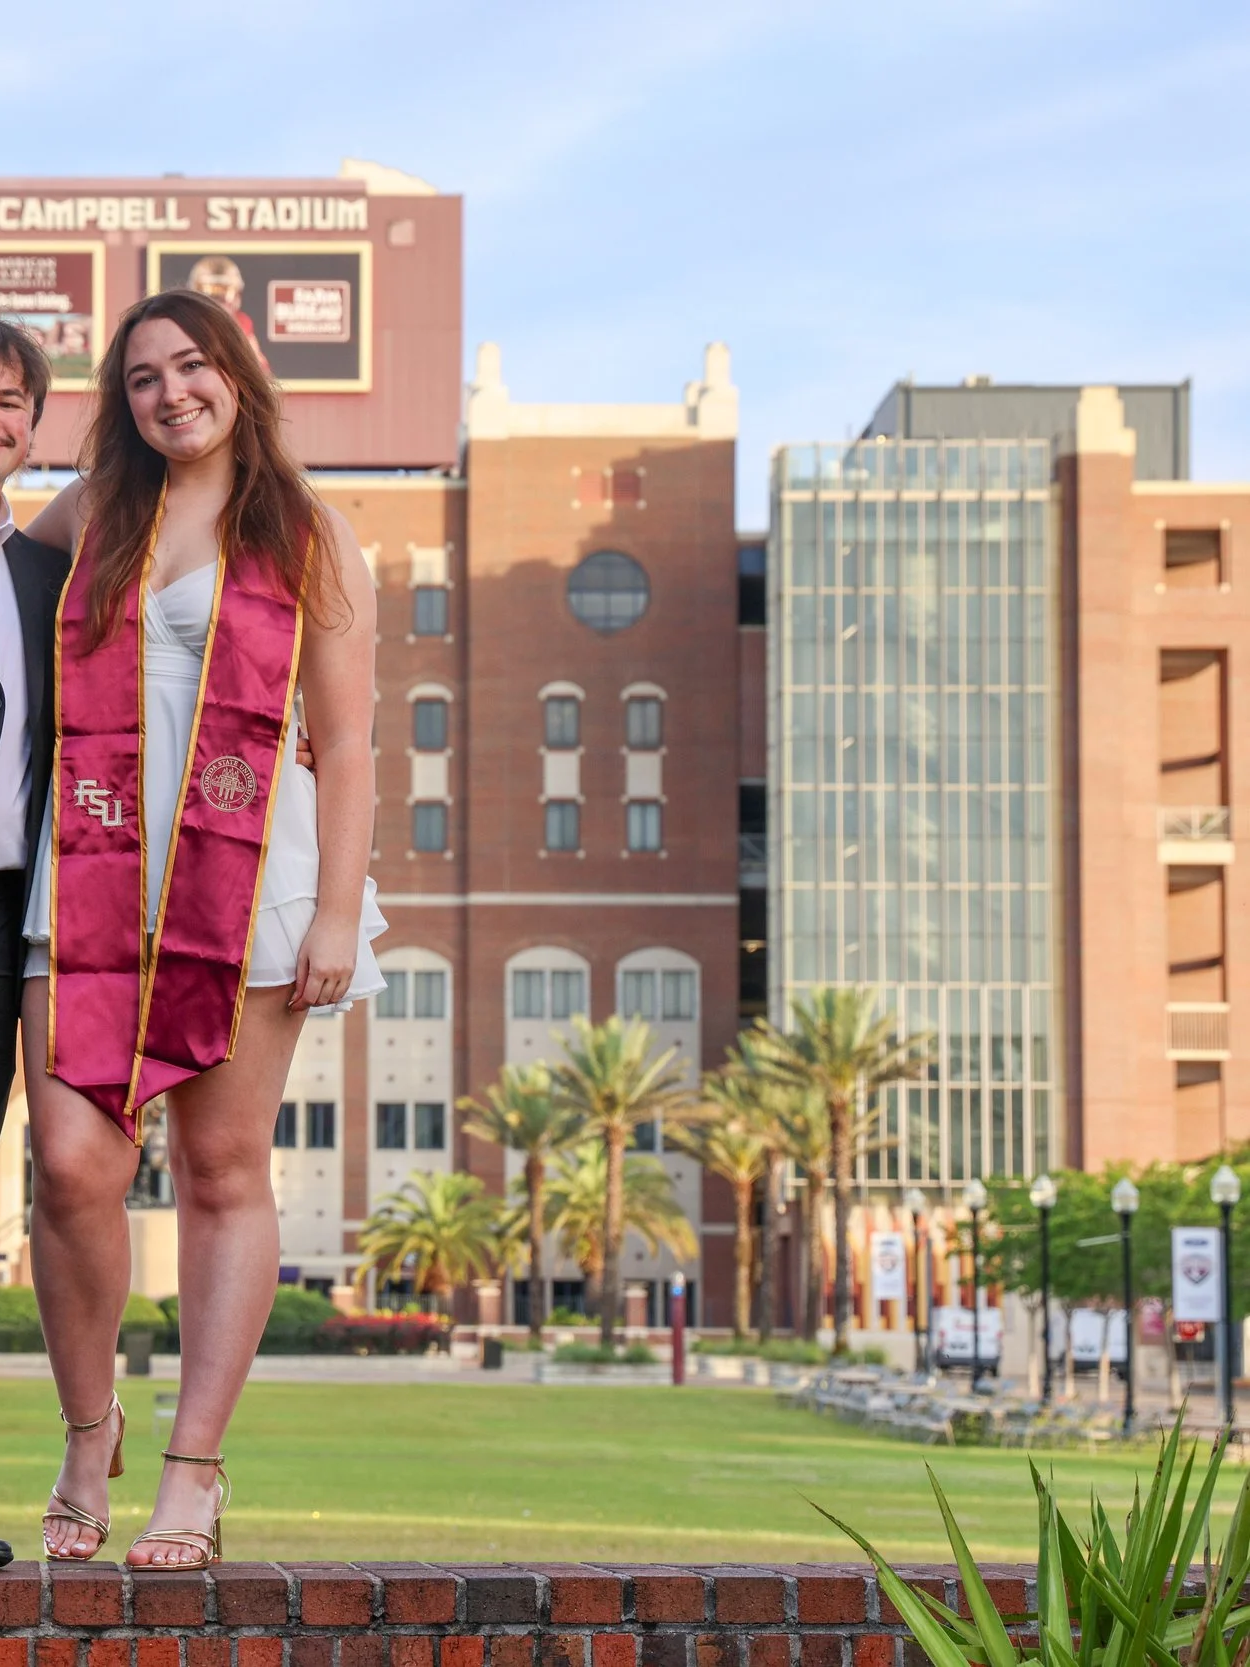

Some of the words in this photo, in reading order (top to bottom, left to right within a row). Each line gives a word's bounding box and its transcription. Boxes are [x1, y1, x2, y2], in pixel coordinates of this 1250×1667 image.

[206, 196, 369, 231] STADIUM
[72, 779, 124, 827] FSU
[203, 764, 218, 794] FLORIDA
[217, 759, 239, 767] STATE
[239, 763, 254, 804] UNIVERSITY
